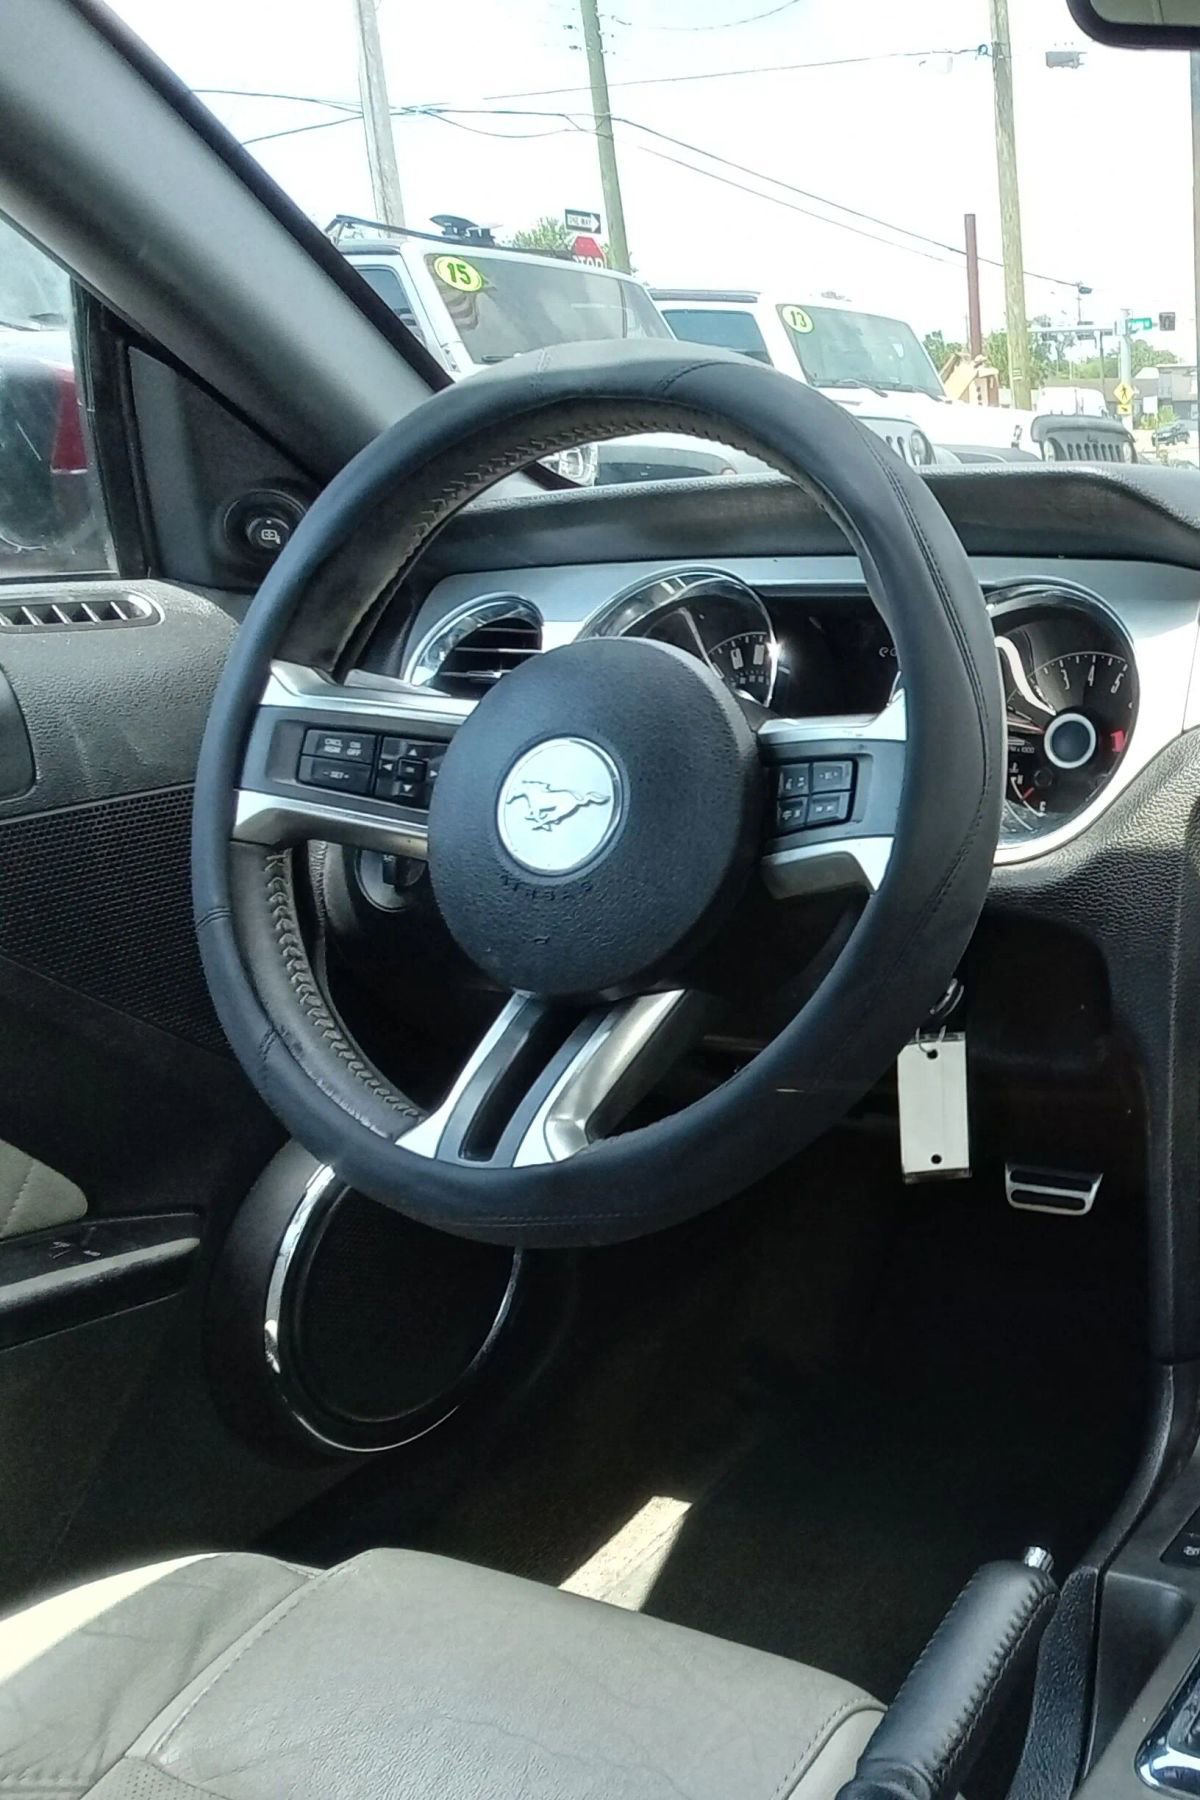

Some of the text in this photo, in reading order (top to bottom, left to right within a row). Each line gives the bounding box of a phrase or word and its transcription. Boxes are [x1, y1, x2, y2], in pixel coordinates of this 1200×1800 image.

[447, 262, 472, 285] 15
[790, 310, 807, 328] 13
[1060, 668, 1071, 690] 3
[1087, 664, 1096, 687] 4
[1110, 673, 1125, 694] 5
